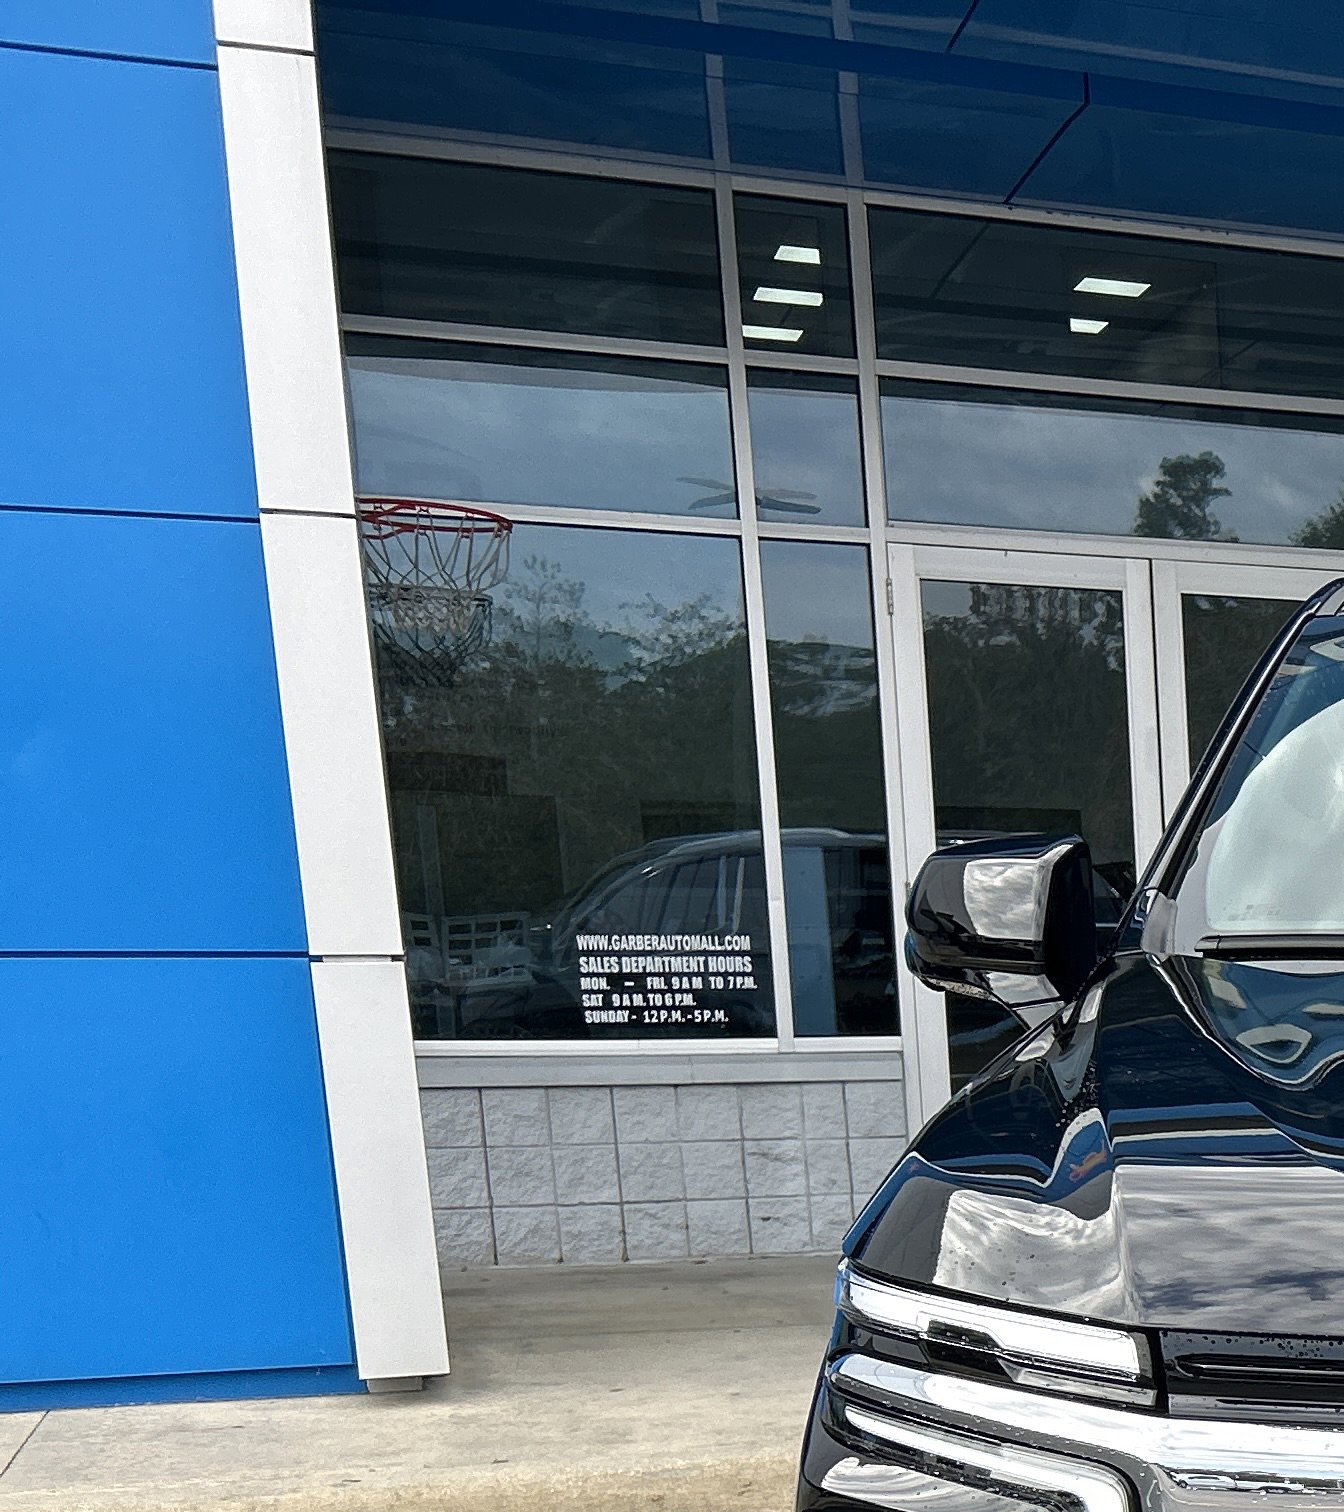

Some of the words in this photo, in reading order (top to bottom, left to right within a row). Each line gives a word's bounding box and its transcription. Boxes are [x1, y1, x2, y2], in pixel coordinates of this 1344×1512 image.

[576, 935, 751, 951] WWW.GARBERAUTOMALL.COM
[579, 956, 620, 973] SALES
[621, 956, 706, 973] DEPARTMENT
[708, 956, 752, 973] HOURS
[580, 977, 610, 990] MON.
[647, 977, 668, 989] FRI.
[709, 977, 723, 989] TO
[582, 994, 603, 1007] SAT
[648, 994, 663, 1006] TO
